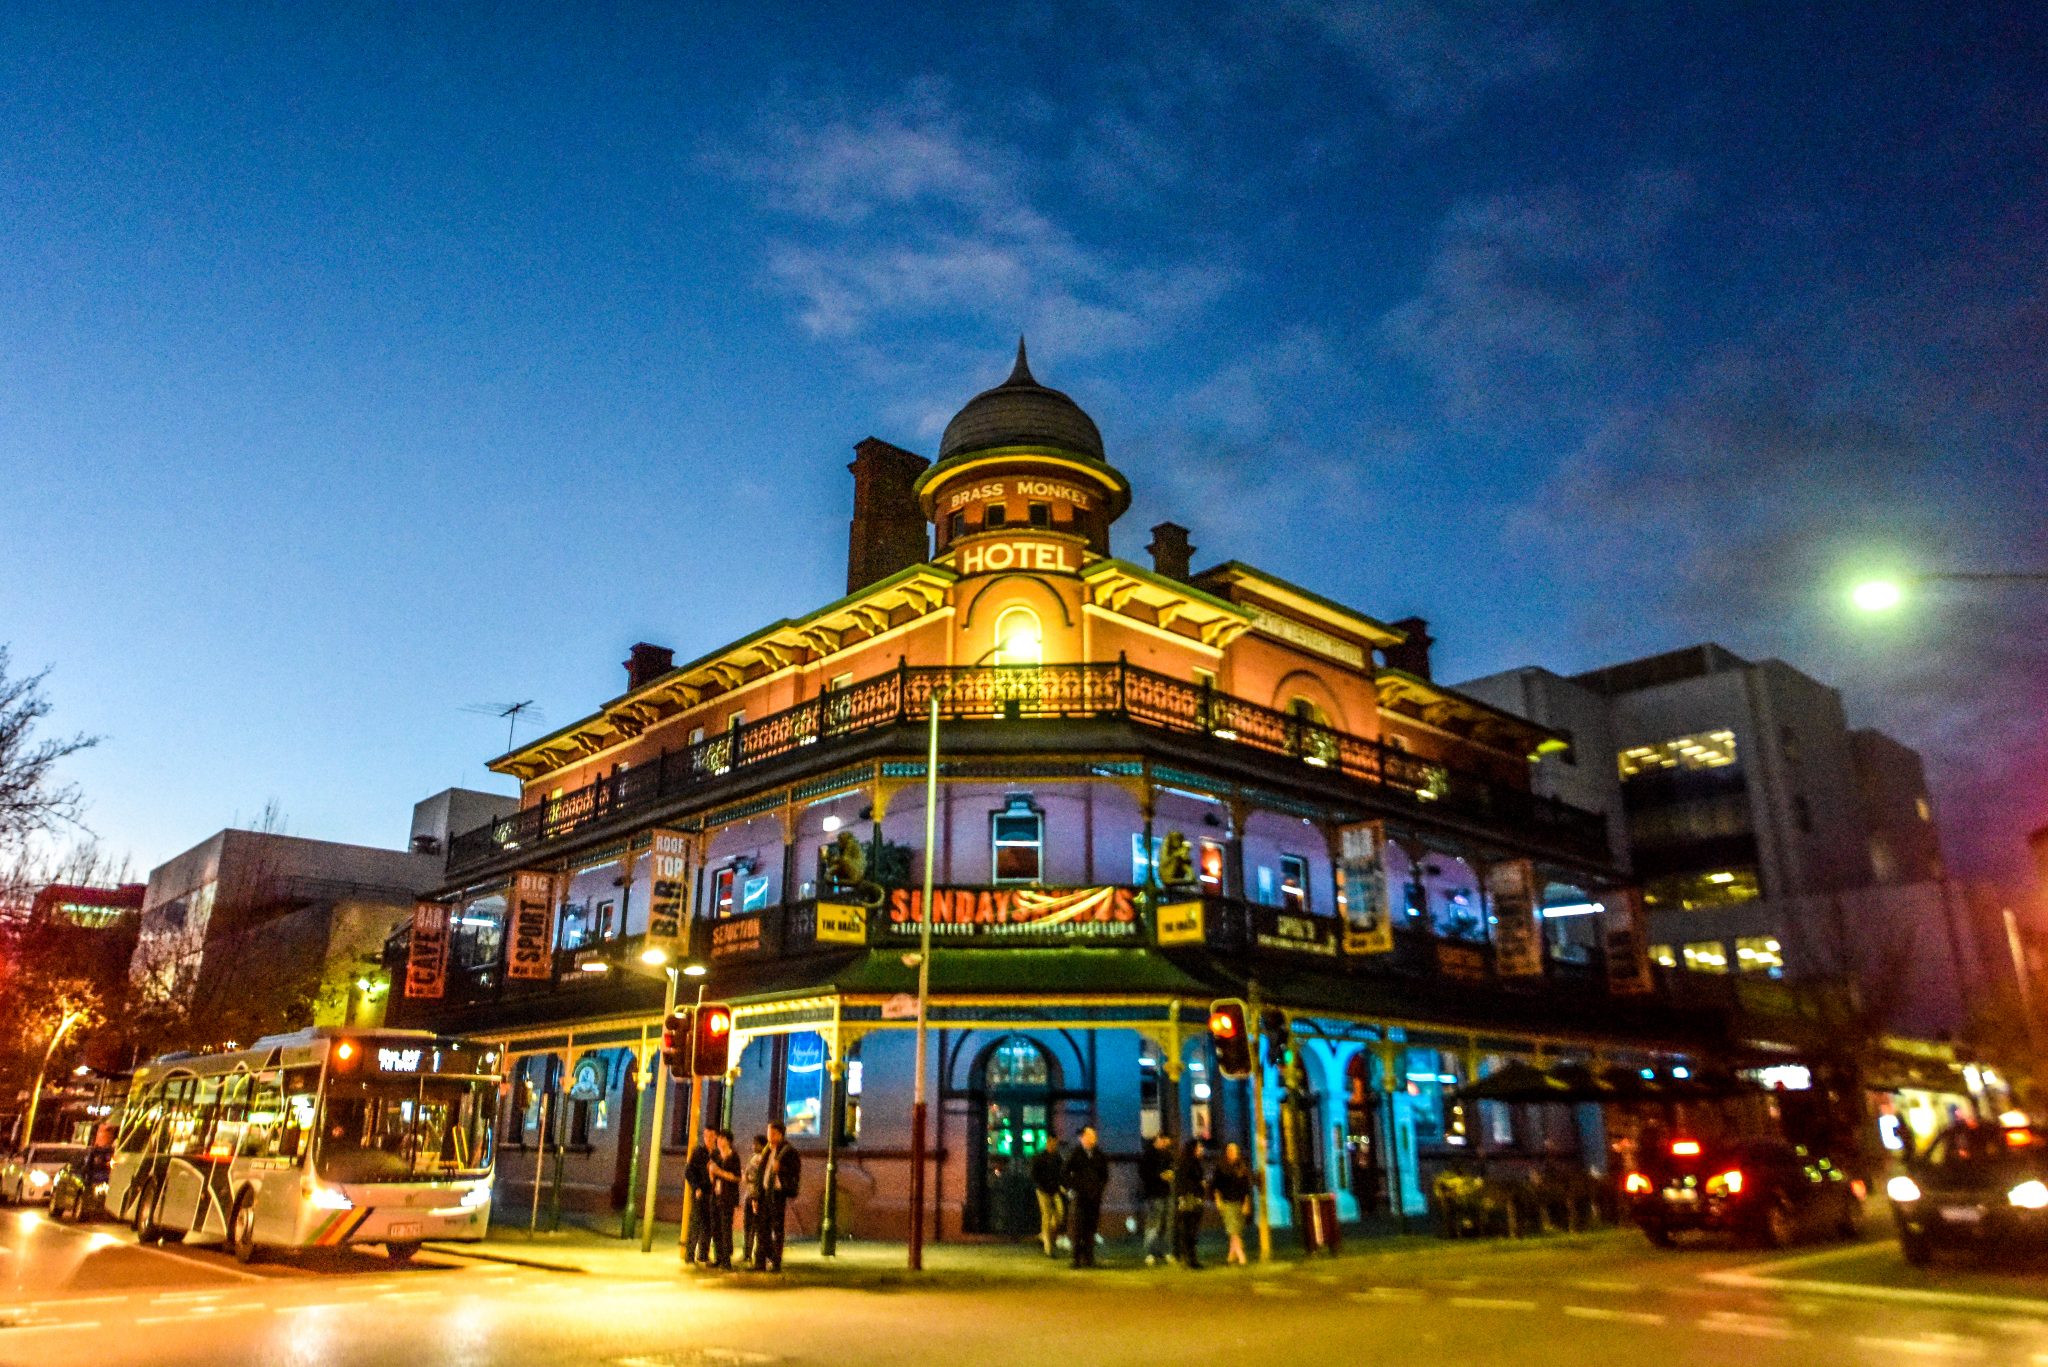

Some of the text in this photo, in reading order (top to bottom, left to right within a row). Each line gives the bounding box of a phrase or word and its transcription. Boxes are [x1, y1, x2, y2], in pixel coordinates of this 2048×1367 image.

[951, 483, 1004, 508] BRASS
[963, 542, 1076, 575] HOTEL
[656, 834, 684, 854] ROOF
[656, 854, 683, 878] TOP
[650, 880, 683, 938] BAR
[516, 899, 546, 962] SPORT
[412, 929, 442, 985] CAVE
